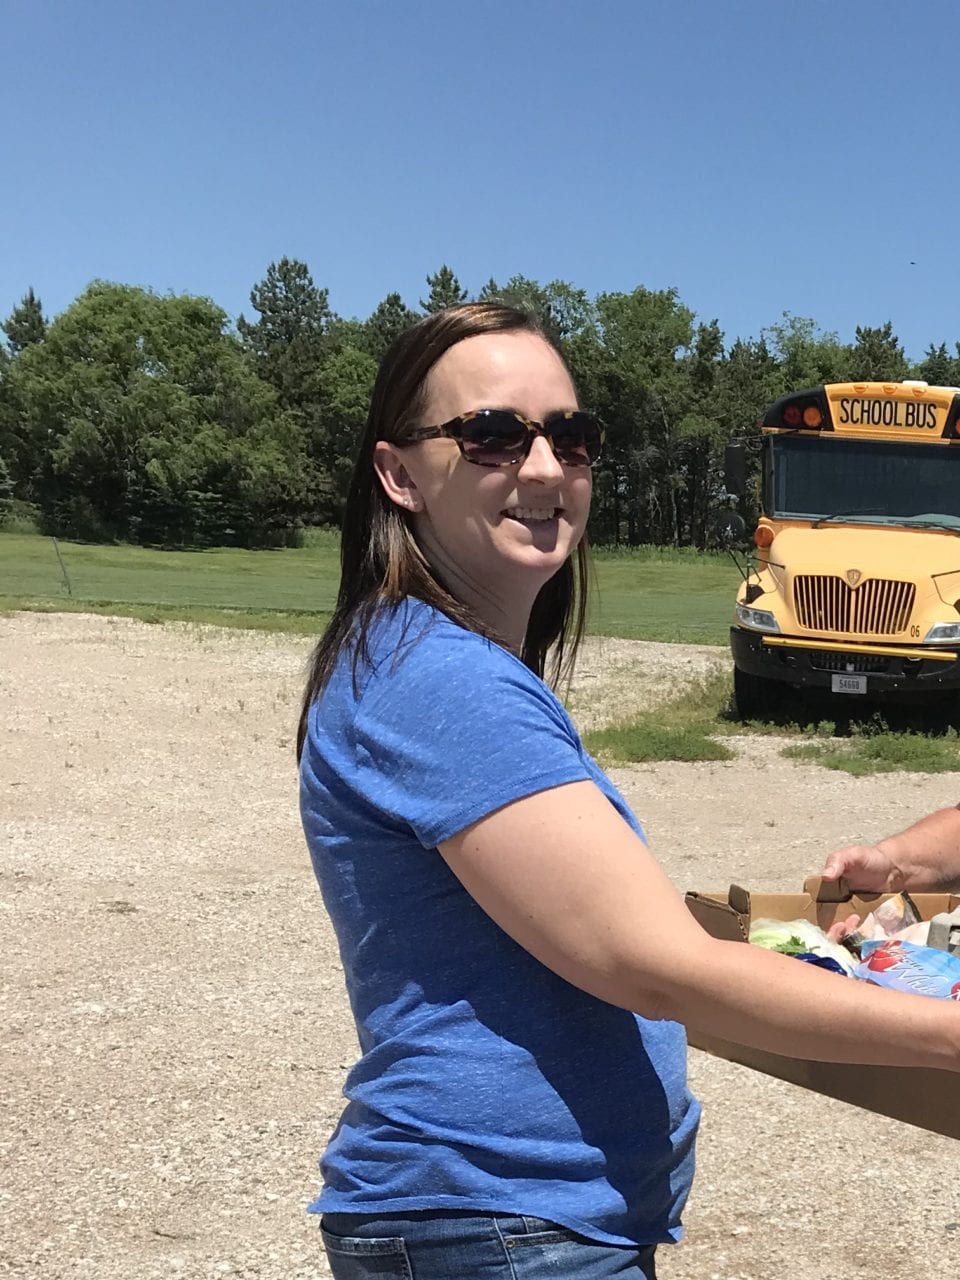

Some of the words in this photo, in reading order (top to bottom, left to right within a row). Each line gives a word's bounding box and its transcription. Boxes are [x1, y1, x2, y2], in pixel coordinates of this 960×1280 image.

[840, 398, 902, 426] SCHOOL
[905, 402, 937, 429] BUS
[910, 625, 920, 638] 06
